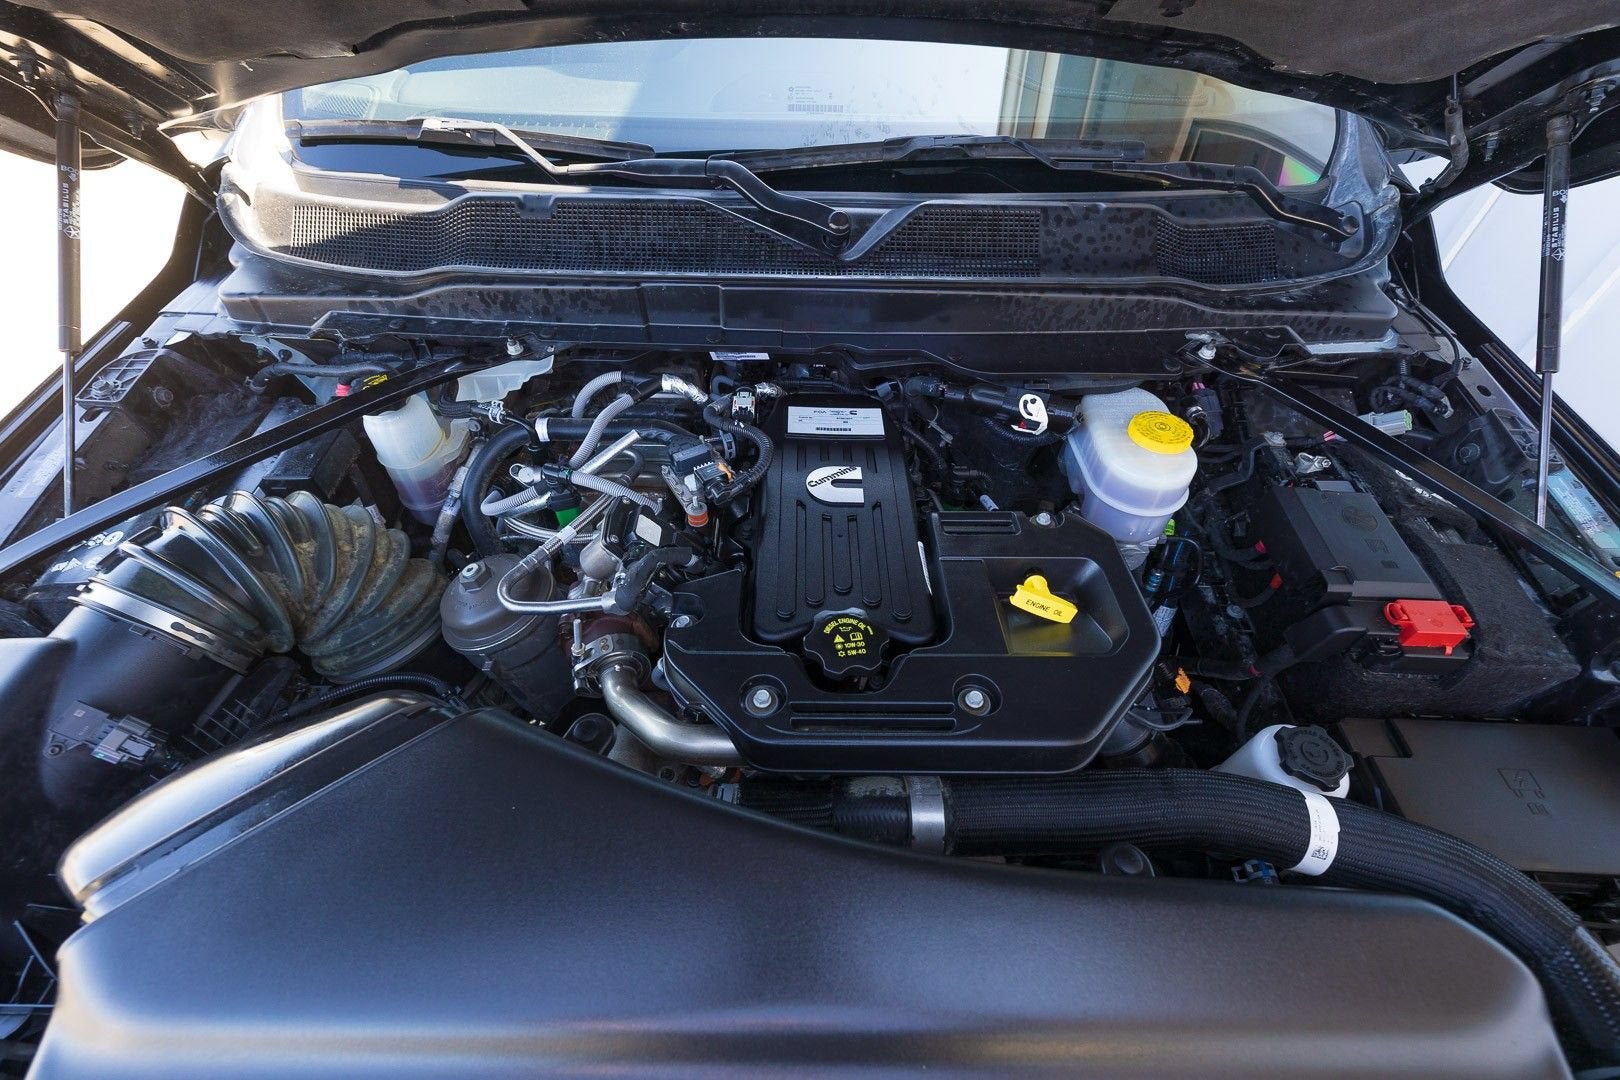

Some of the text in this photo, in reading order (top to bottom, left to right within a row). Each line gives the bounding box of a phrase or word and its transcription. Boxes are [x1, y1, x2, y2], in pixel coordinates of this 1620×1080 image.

[1551, 207, 1560, 248] STABILUS
[807, 466, 857, 488] Cummins
[1025, 599, 1063, 617] ENGINE OIL
[823, 620, 839, 634] DIESEL
[838, 617, 859, 625] ENGINE
[857, 621, 866, 630] OIL
[847, 648, 867, 656] 5W-40
